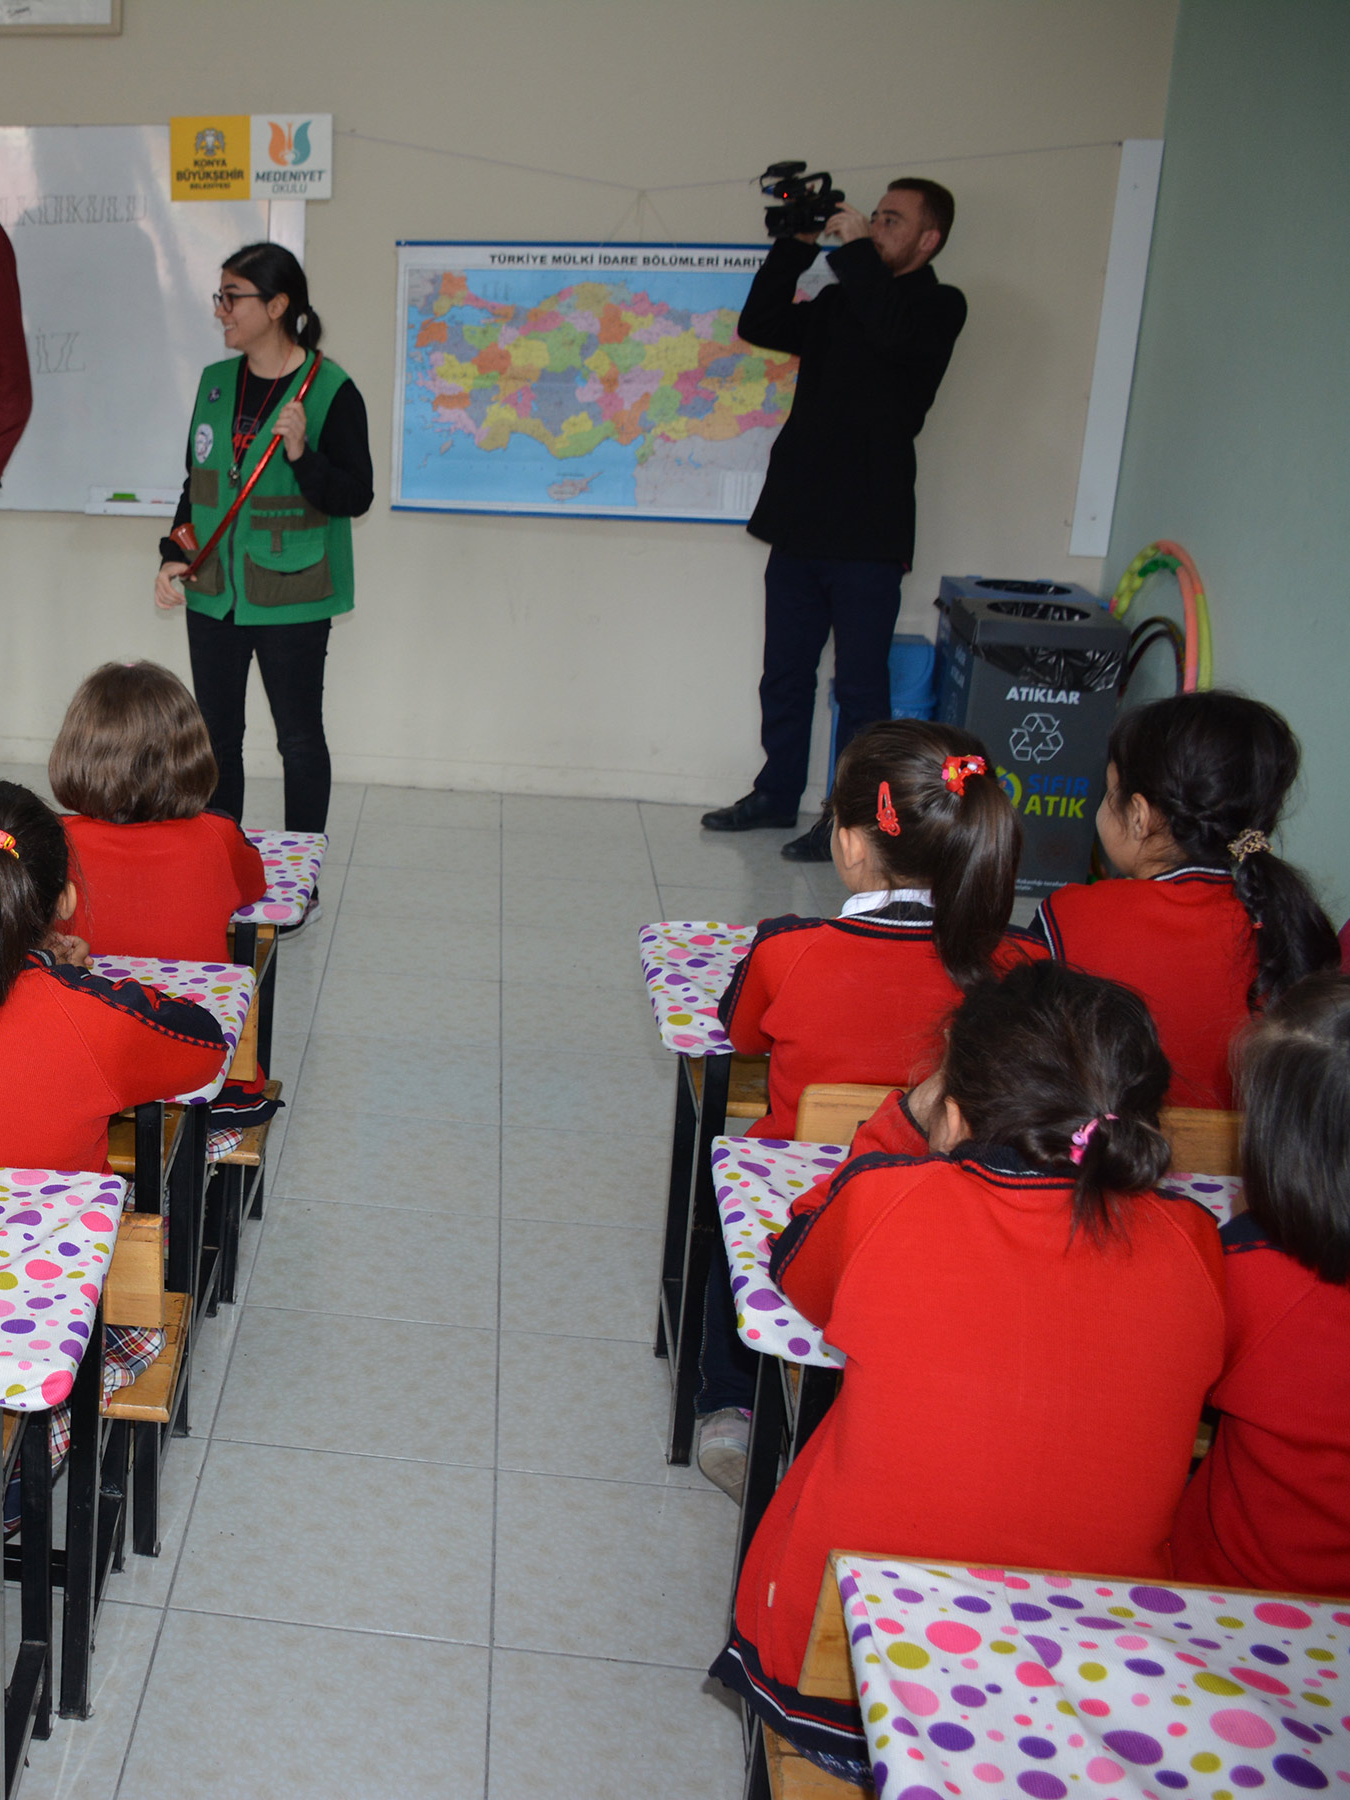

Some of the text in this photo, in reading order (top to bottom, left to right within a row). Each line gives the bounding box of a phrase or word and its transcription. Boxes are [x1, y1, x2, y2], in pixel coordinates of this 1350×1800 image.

[193, 158, 227, 168] KONYA
[176, 168, 244, 182] BÜYÜKŞEHİR
[271, 183, 308, 194] OKULU
[488, 253, 766, 269] TÜRKİYE MÜLKİ İDARE BÖLÜMLERİ HARİT
[1005, 685, 1080, 705] ATIKLAR
[1027, 774, 1089, 796] SIFIR
[1024, 795, 1086, 818] ATIK
